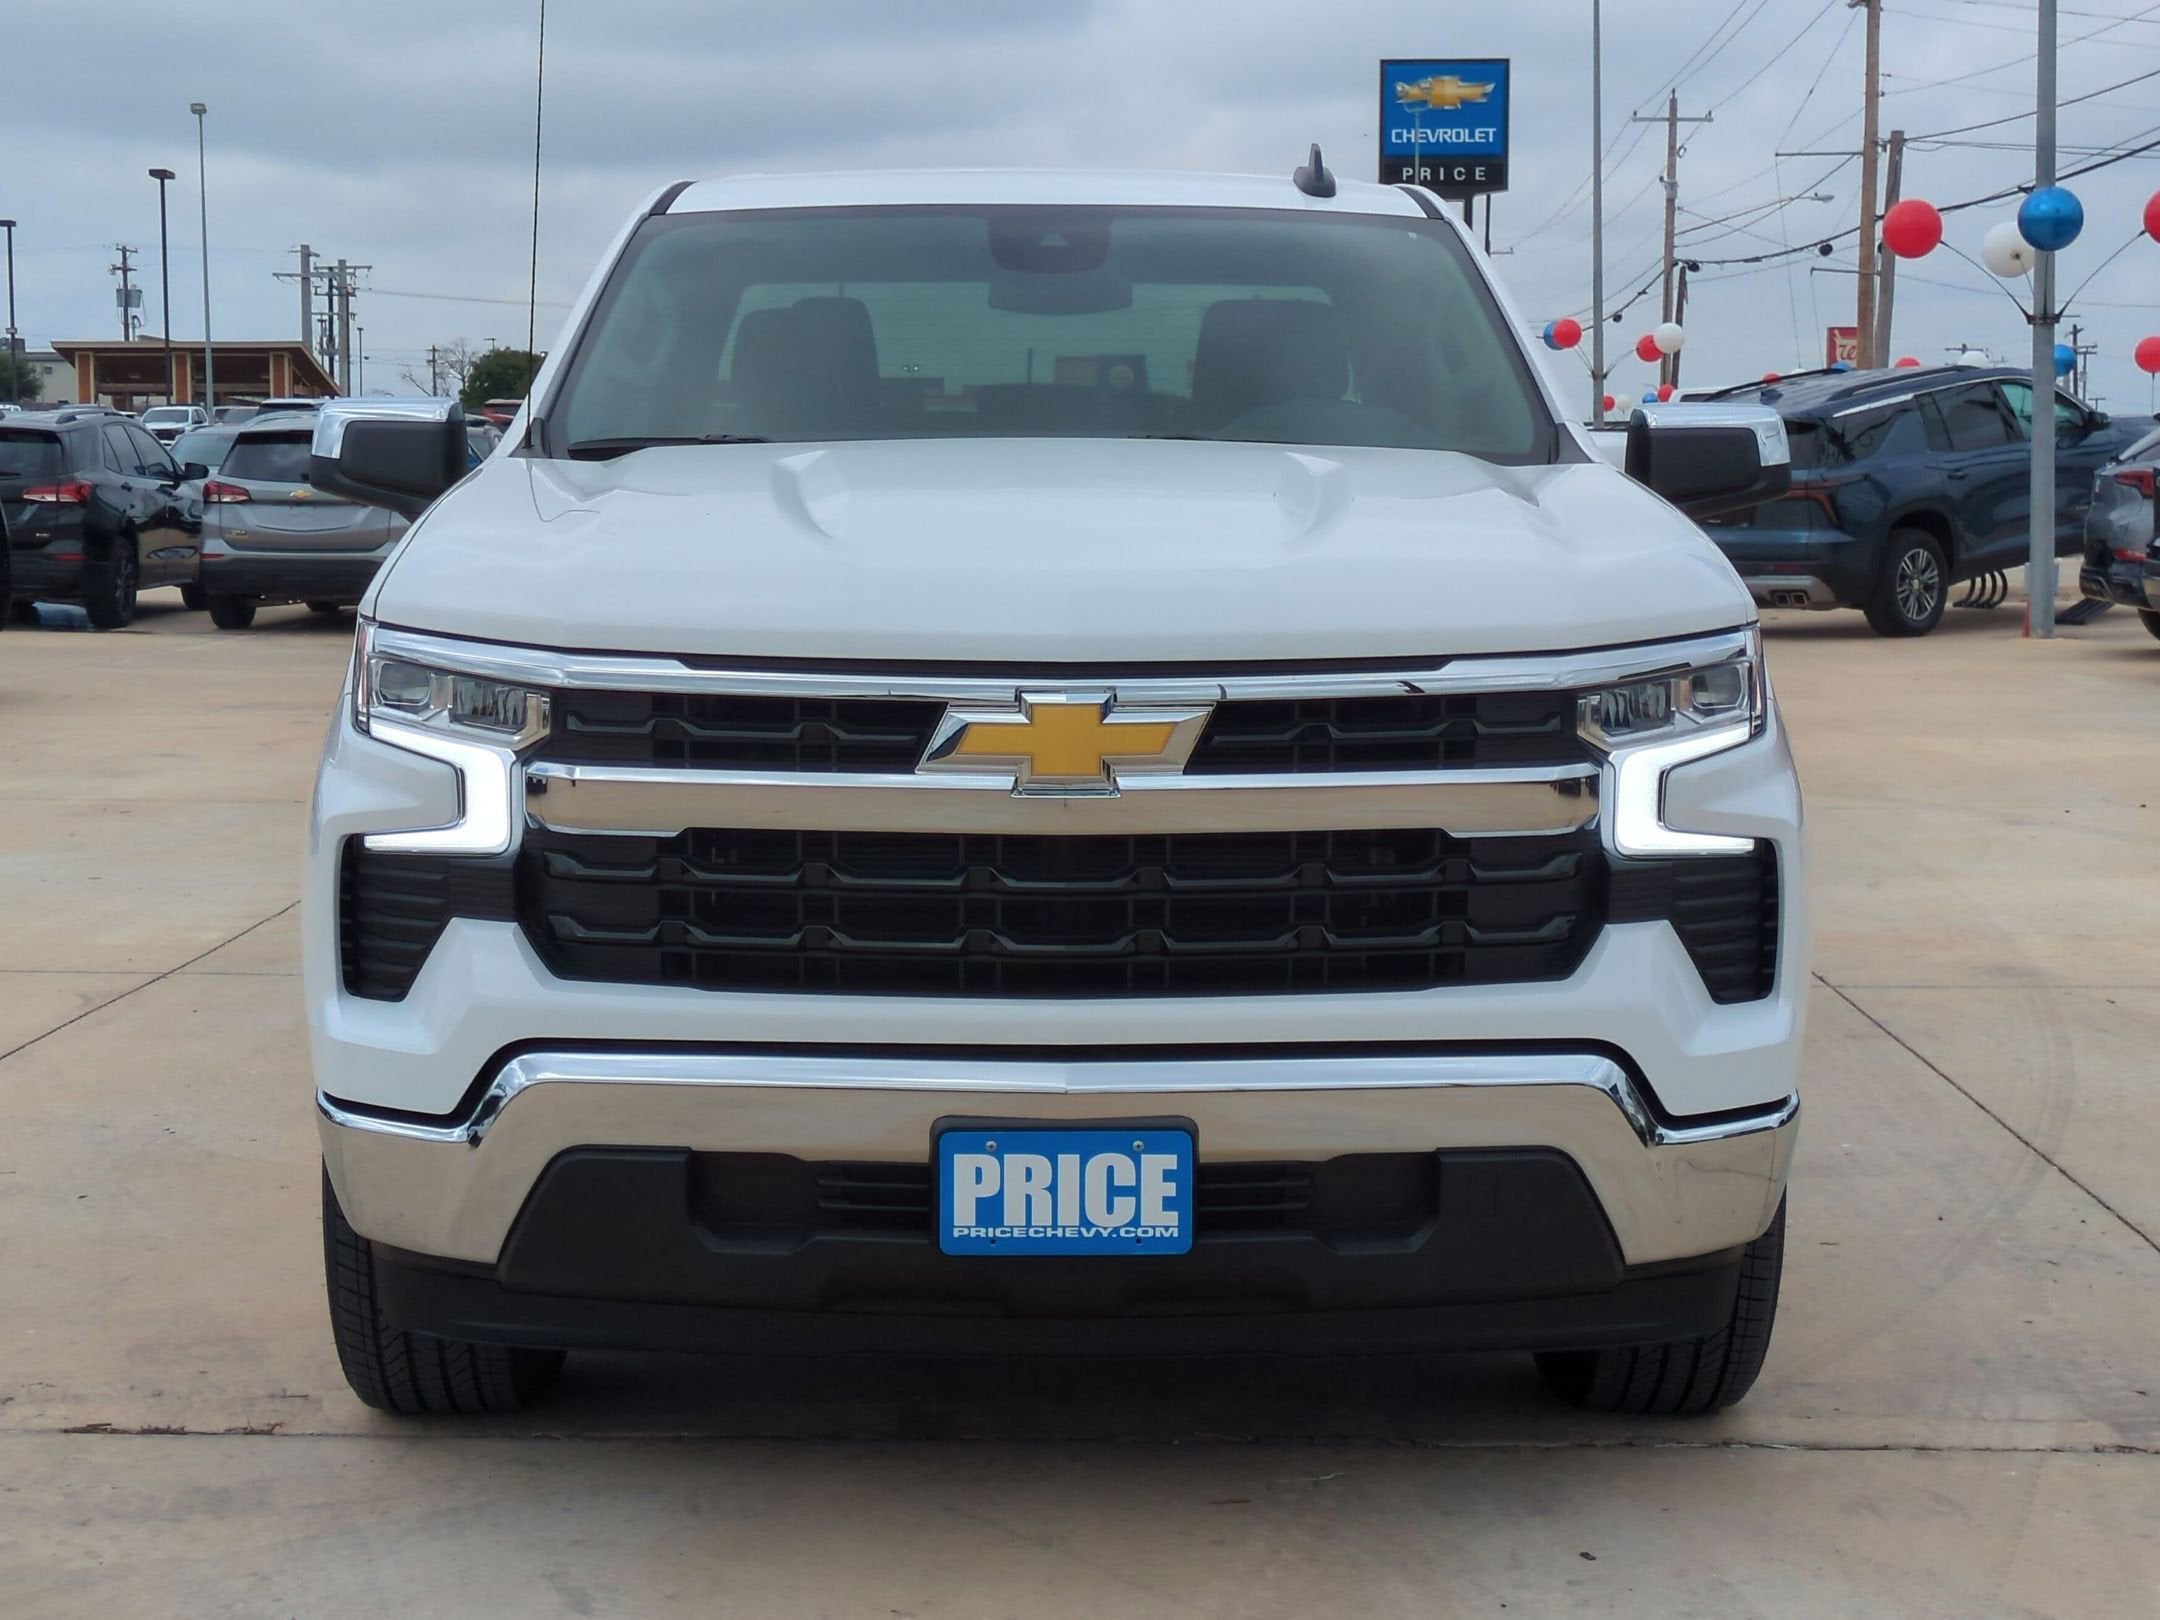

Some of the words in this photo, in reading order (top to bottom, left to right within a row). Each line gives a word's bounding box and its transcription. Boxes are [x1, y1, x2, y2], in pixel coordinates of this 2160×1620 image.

[1391, 128, 1497, 143] CHEVROLET
[1402, 166, 1486, 181] PRICE
[953, 1152, 1179, 1228] PRICE
[953, 1226, 1179, 1238] PRICECHEVY.COM
